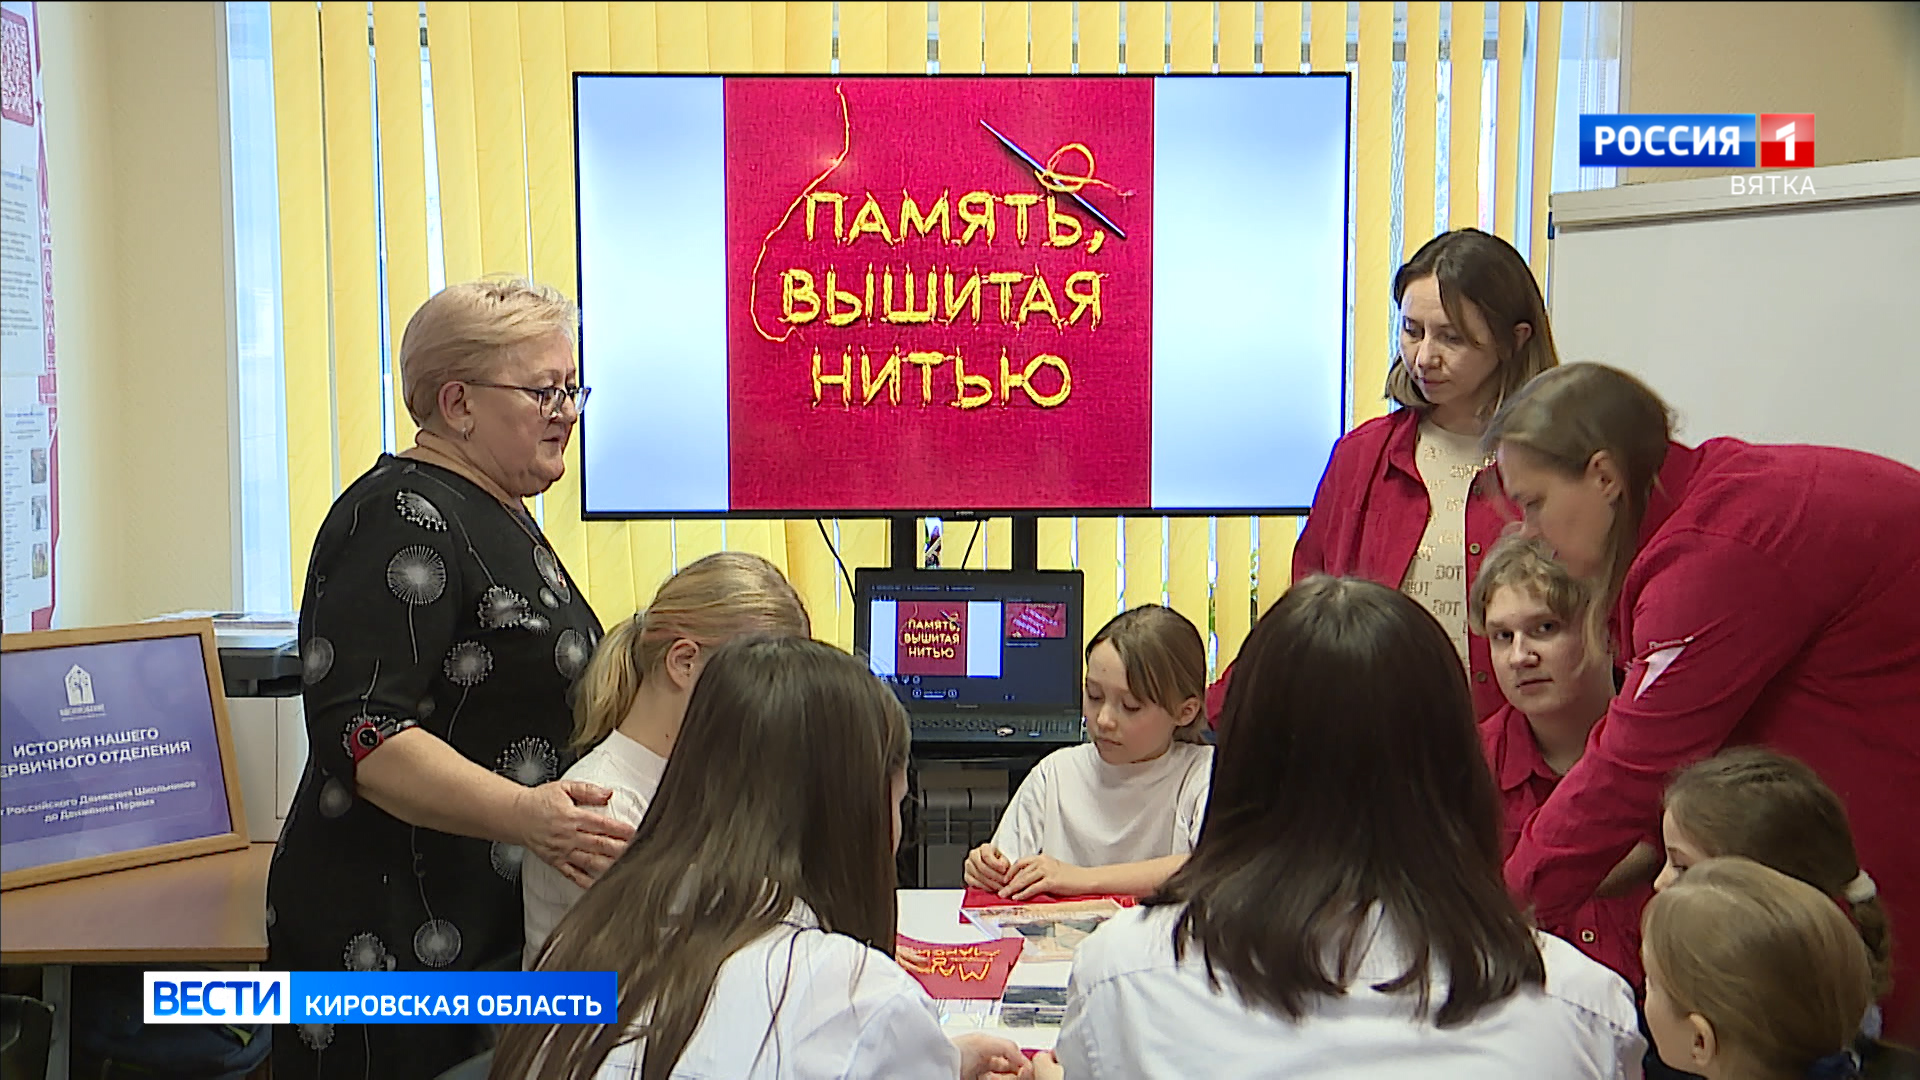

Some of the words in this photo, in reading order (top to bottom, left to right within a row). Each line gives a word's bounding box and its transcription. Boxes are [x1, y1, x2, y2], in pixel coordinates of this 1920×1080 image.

[804, 189, 1105, 253] ПАМЯТЬ,
[779, 265, 1107, 332] ВЫШИТАЯ
[810, 346, 1073, 409] НИТЬЮ
[904, 632, 960, 645] ВЫШИТАЯ
[908, 646, 955, 658] НИТЬЮ
[13, 737, 92, 758] ИСТОРИЯ
[94, 727, 159, 748] НАШЕГО
[99, 741, 191, 764] ОТДЕЛЕНИЯ
